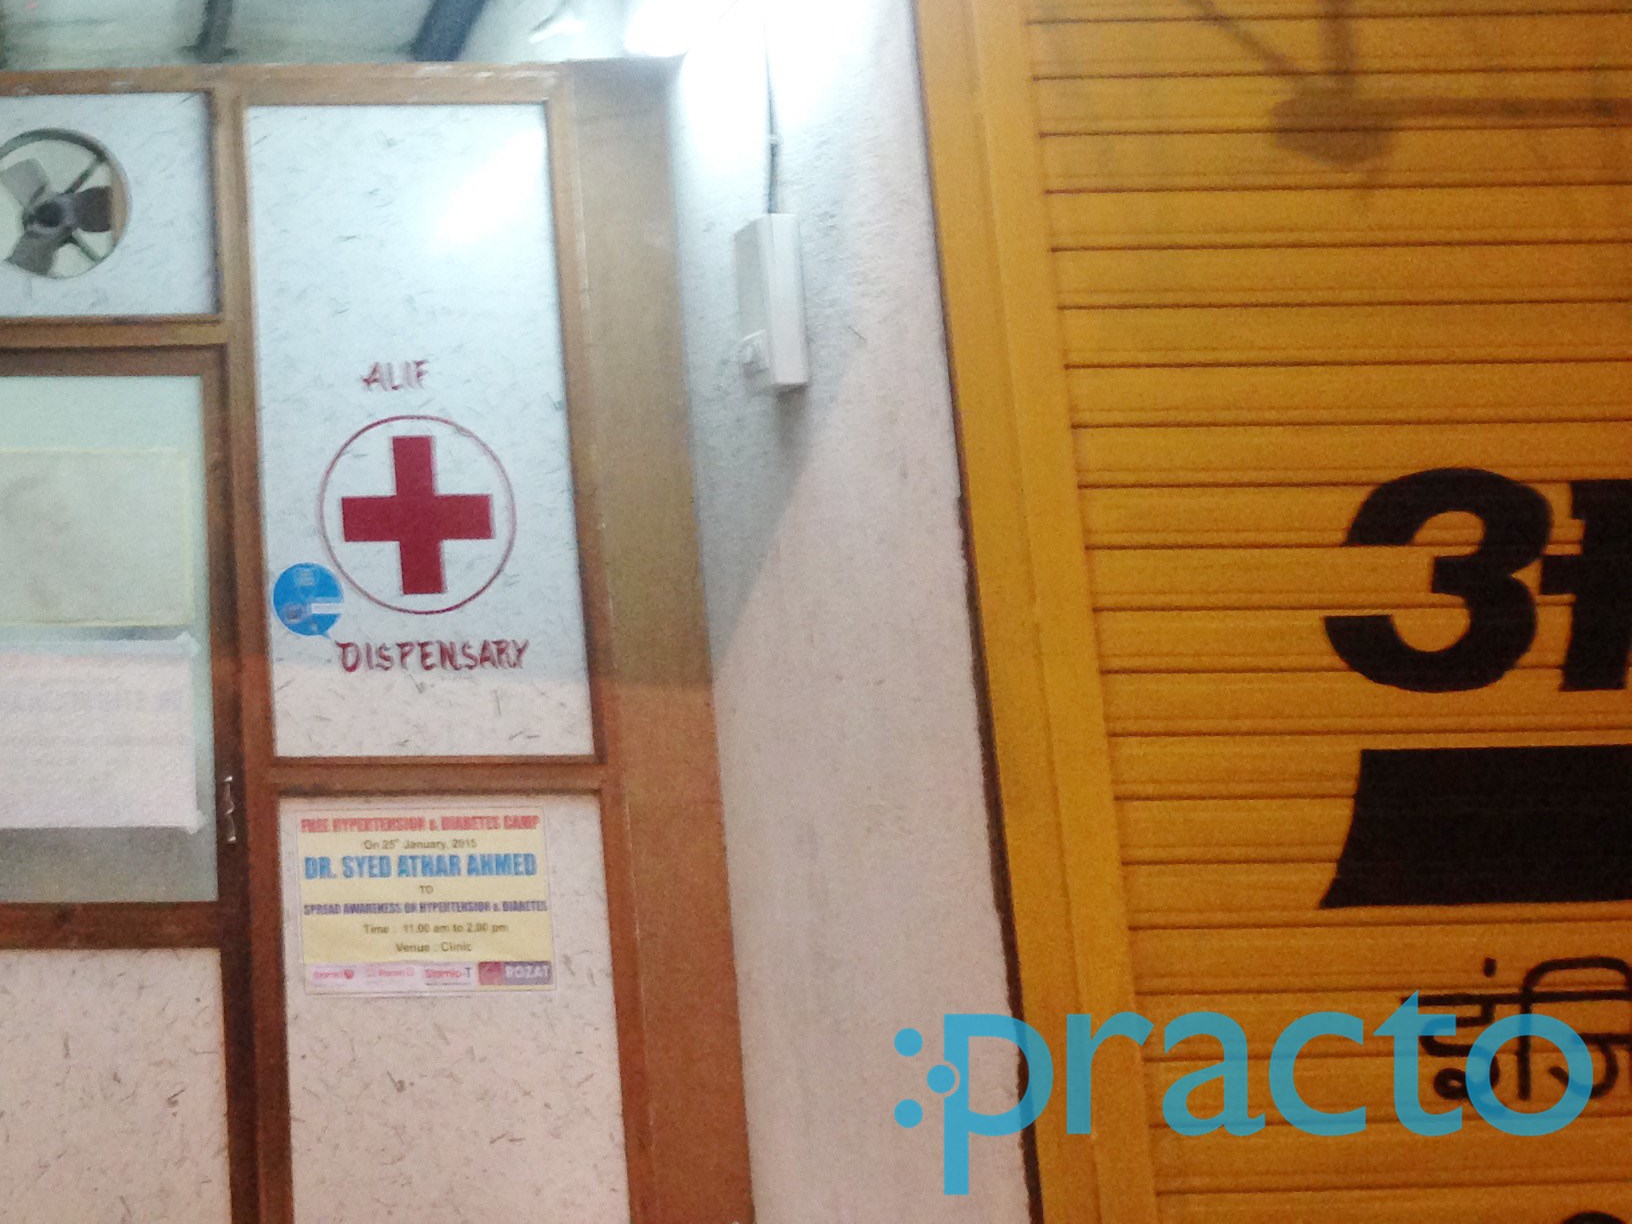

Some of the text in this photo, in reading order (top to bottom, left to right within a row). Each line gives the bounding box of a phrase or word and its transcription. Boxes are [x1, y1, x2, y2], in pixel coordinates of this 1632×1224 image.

[361, 358, 429, 393] ALIF
[333, 639, 531, 674] DISPENSARY
[304, 852, 538, 880] DR. SYED ATHAR AHMED
